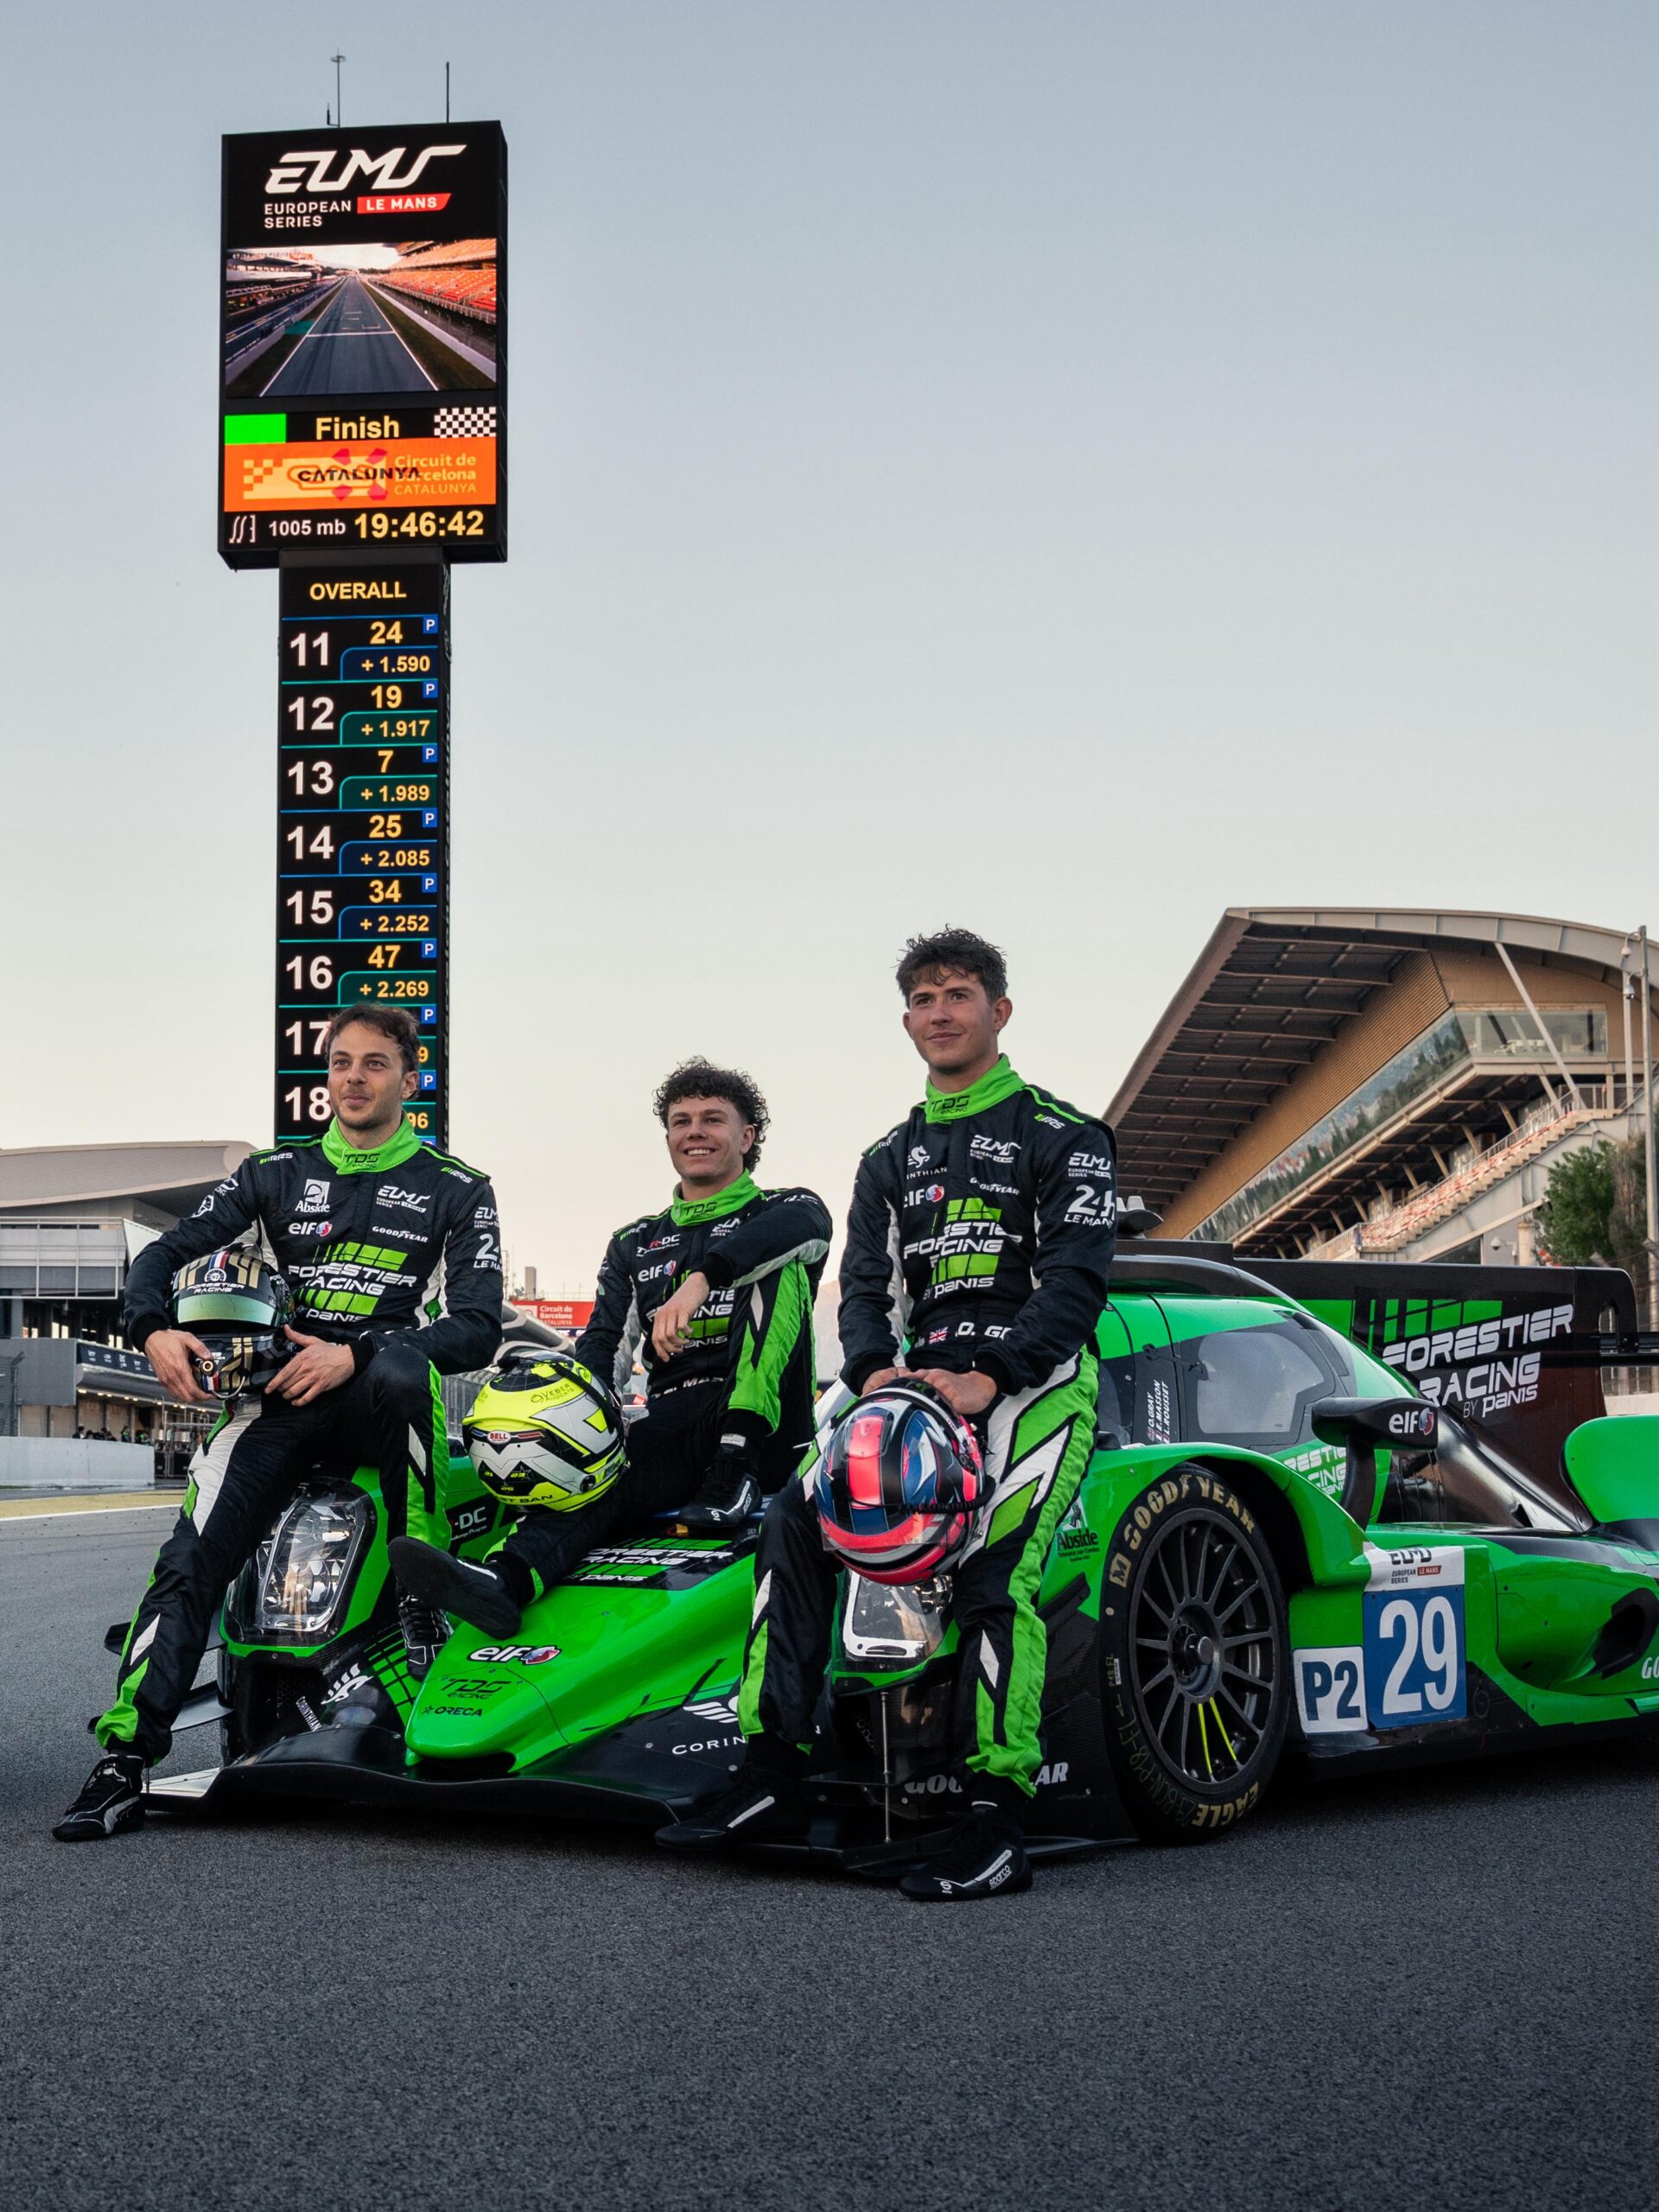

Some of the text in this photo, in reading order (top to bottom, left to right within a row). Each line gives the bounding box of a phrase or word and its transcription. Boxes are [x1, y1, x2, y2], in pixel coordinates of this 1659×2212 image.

[264, 144, 467, 194] ELMS
[264, 196, 437, 216] EUROPEAN LE MANS
[264, 216, 322, 229] SERIES
[315, 416, 400, 440] Finish
[394, 453, 477, 467] Circuit de
[297, 467, 422, 482] CATALUNYA
[394, 482, 477, 496] CATALUNYA
[269, 510, 485, 539] 1005 mb 19:46:42
[309, 582, 407, 601] OVERALL
[370, 620, 435, 645] 24 P
[290, 632, 328, 666] 11
[380, 655, 430, 673] 1.590
[371, 683, 435, 709] 19 P
[288, 696, 334, 731] 12
[379, 720, 430, 737] 1.917
[378, 748, 435, 773] 7 P
[288, 761, 334, 795] 13
[379, 785, 429, 802] 1.989
[369, 813, 435, 838] 25 P
[287, 826, 334, 860] 14
[378, 849, 429, 867] 2.085
[369, 878, 435, 904] 34 P
[286, 890, 334, 925] 15
[378, 915, 429, 932] 2.252
[368, 944, 434, 969] 47 P
[286, 956, 333, 990] 16
[377, 981, 429, 997] 2.269
[424, 1009, 434, 1020] P
[285, 1021, 332, 1055] 17
[423, 1075, 434, 1087] P
[285, 1087, 332, 1121] 18
[931, 1095, 971, 1112] TDS
[940, 1107, 968, 1116] RACING
[906, 1166, 948, 1179] INTHIAN
[969, 1177, 1020, 1195] GODYEAR
[295, 1200, 330, 1213] Abside
[288, 1221, 317, 1235] elf
[1064, 1214, 1083, 1223] LE
[372, 1226, 429, 1243] GOODYEAR
[930, 1239, 1004, 1268] RCING
[490, 1261, 503, 1272] MA
[638, 1264, 664, 1282] elf
[187, 1282, 245, 1291] FORESTIER
[693, 1304, 734, 1319] ING
[1382, 1303, 1574, 1372] FORESTIER
[1419, 1351, 1541, 1408] RACING
[1161, 1381, 1171, 1435] L.ROUSSET
[1463, 1399, 1478, 1418] BY
[1389, 1411, 1419, 1433] elf
[1284, 1445, 1346, 1472] RESTIE
[454, 1506, 486, 1529] -DC
[1123, 1473, 1255, 1550] GOODYEAR
[1056, 1529, 1099, 1551] Abside
[581, 1556, 689, 1566] RACING
[588, 1548, 734, 1559] ORESTIER
[1392, 1568, 1416, 1577] EUROPEAN
[470, 1646, 529, 1662] elf
[1379, 1596, 1458, 1714] 29
[441, 1679, 512, 1693] TDS
[1301, 1660, 1361, 1721] P2
[435, 1707, 482, 1716] ORECA
[671, 1735, 747, 1755] CORIN
[1192, 1781, 1259, 1827] EAGLE
